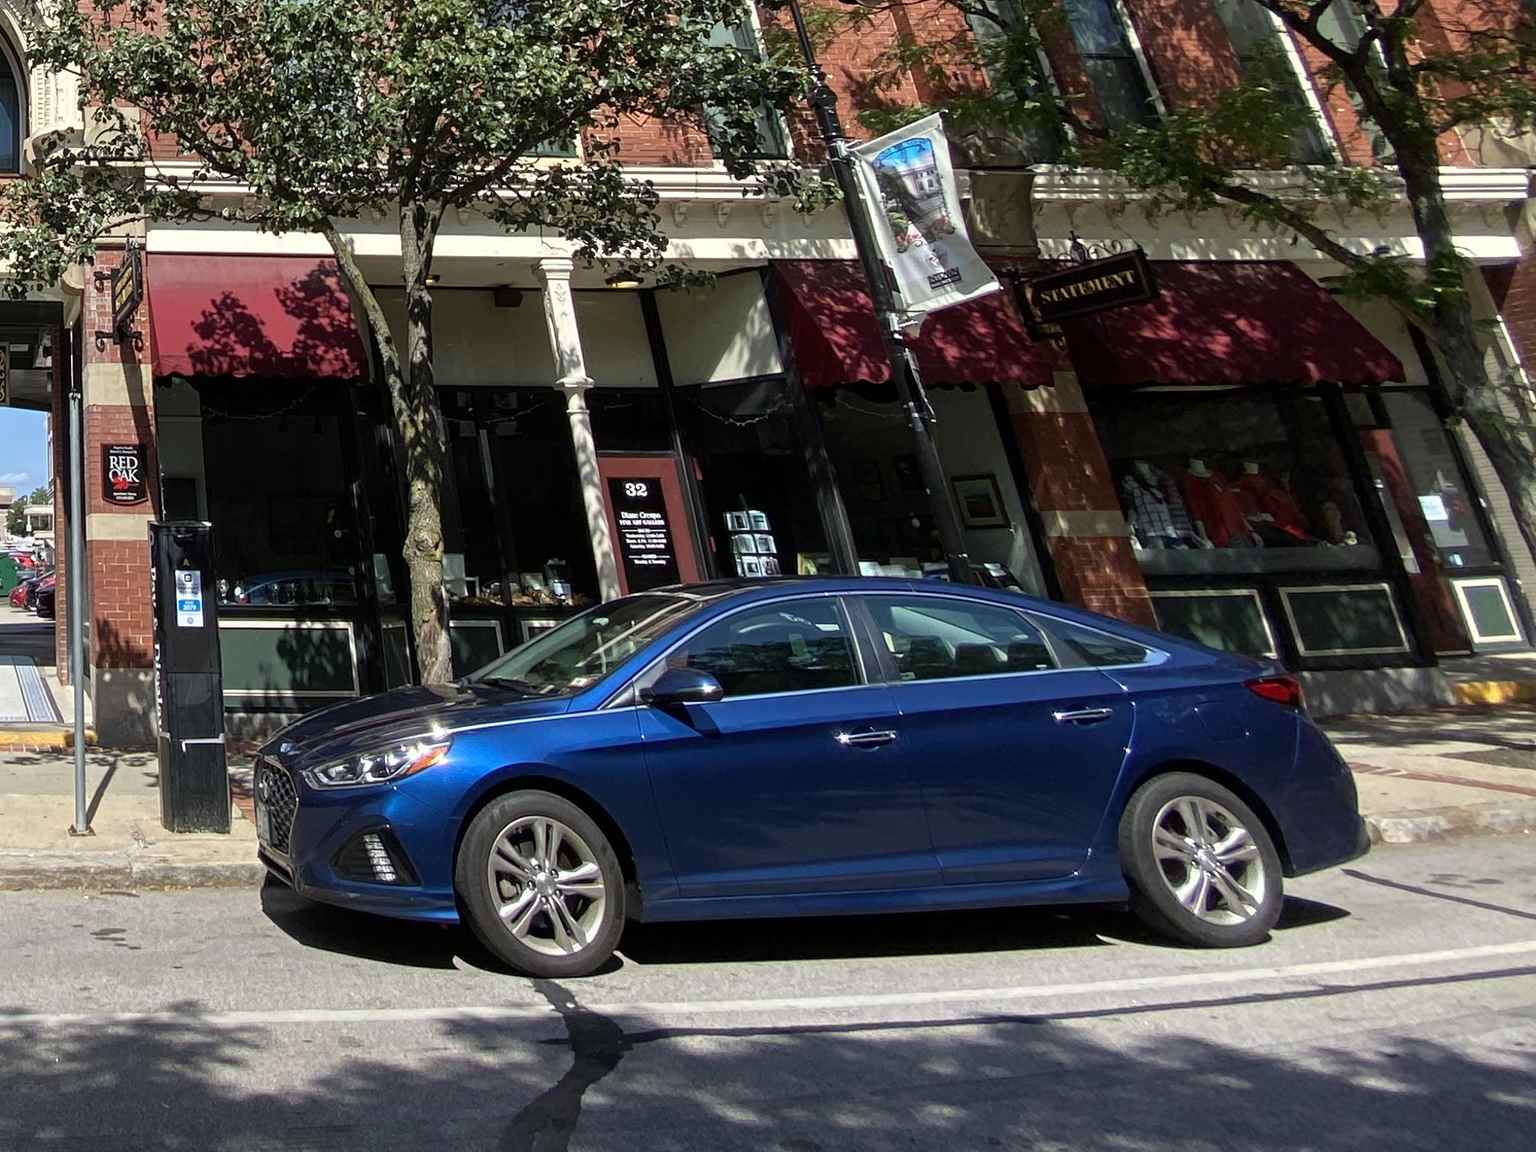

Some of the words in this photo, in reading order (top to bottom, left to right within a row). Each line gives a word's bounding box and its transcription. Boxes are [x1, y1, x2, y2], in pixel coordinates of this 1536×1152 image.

[1040, 270, 1135, 304] STATEMENT
[109, 455, 138, 470] RED
[108, 468, 140, 483] OAK
[625, 482, 648, 497] 32
